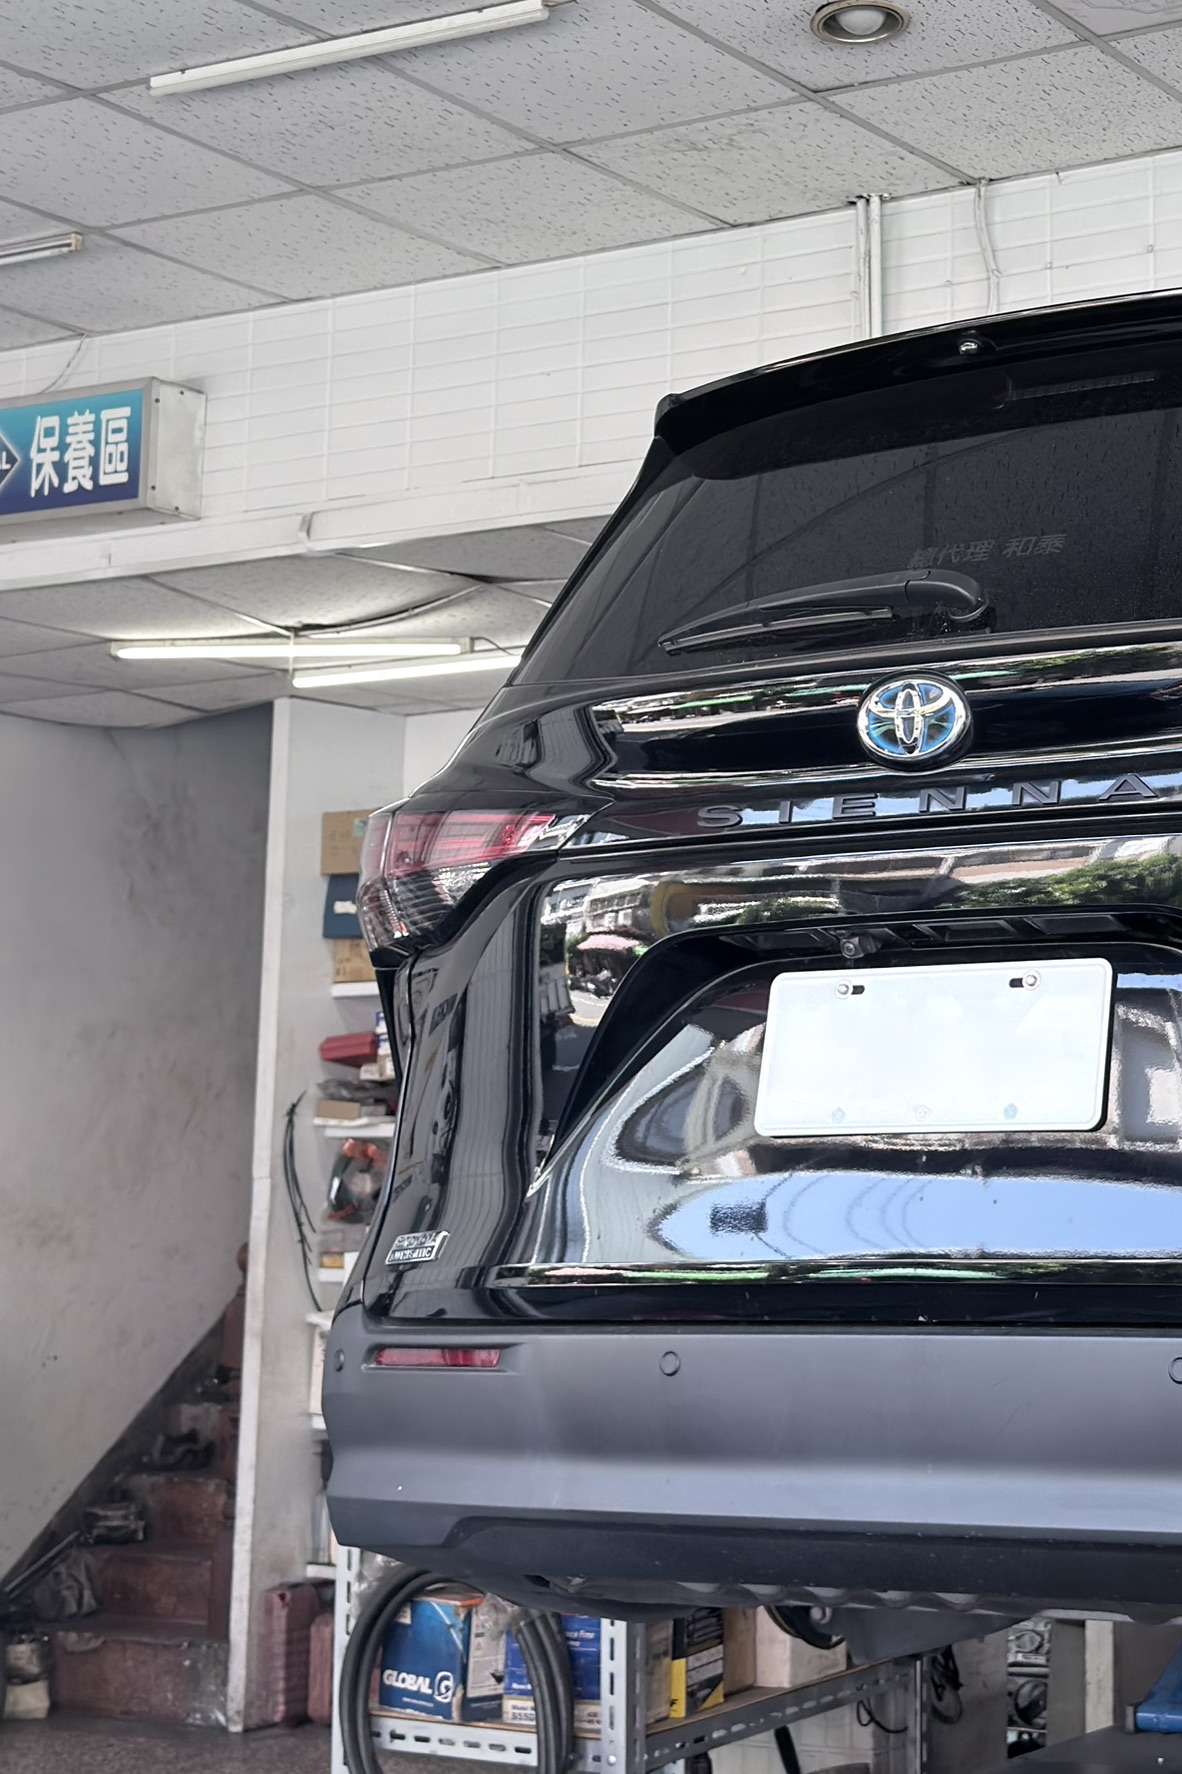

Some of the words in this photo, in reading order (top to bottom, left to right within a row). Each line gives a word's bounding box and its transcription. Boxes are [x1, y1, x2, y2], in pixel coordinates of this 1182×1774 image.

[30, 406, 132, 498] 保養區
[697, 773, 1159, 828] SIENNA
[382, 1669, 433, 1695] GLOBAL
